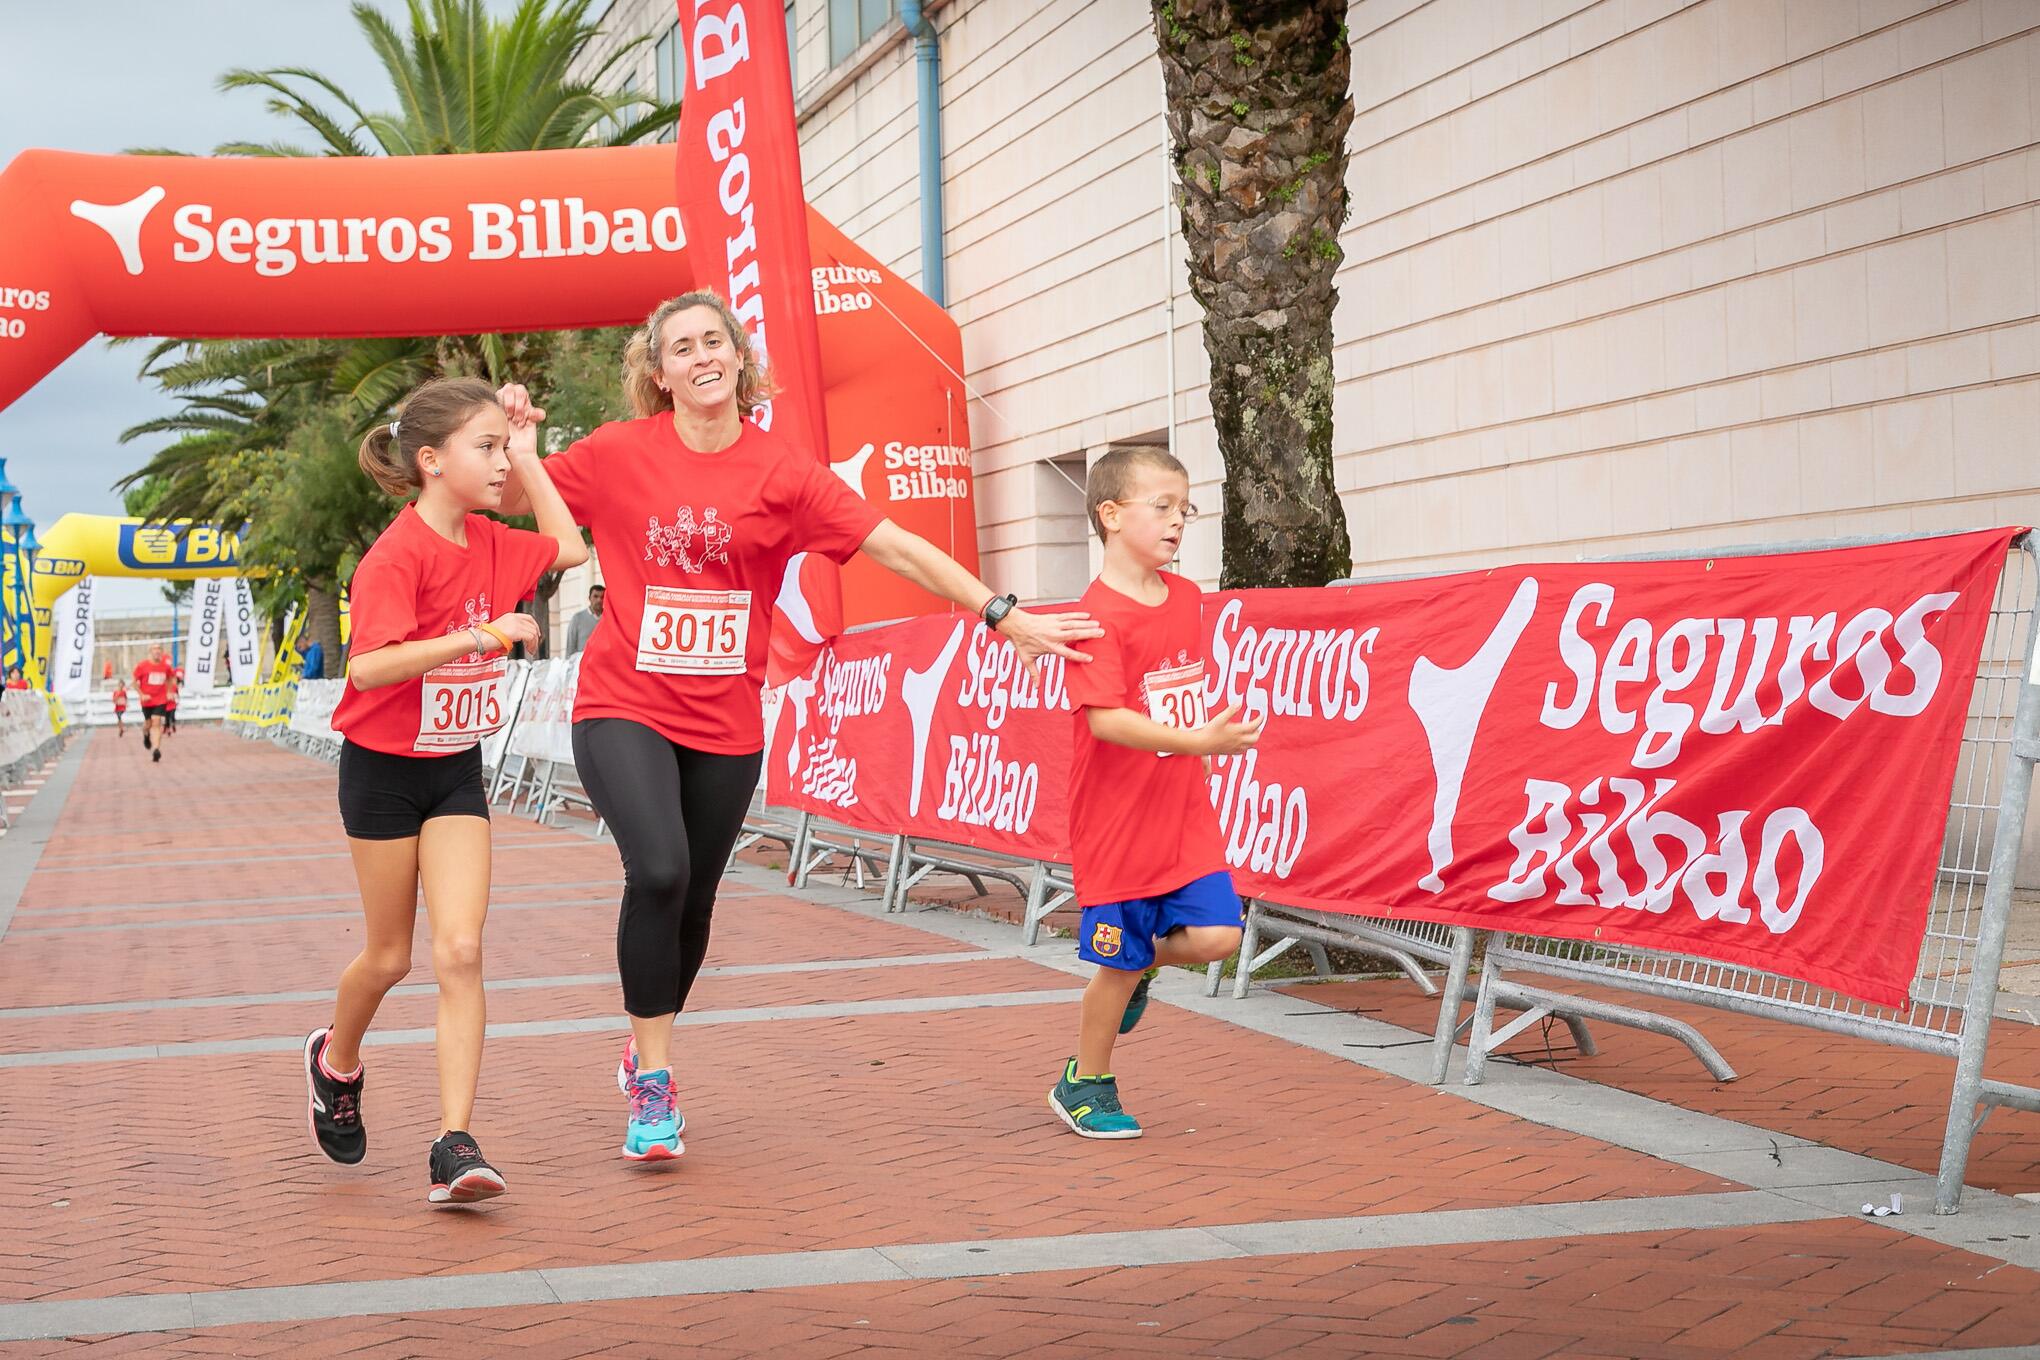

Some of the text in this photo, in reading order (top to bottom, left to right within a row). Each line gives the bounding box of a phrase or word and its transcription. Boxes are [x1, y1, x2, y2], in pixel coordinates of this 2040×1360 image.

[173, 197, 688, 277] Seguros Bilbao
[884, 441, 972, 472] Seguros
[887, 471, 968, 501] Bilbao
[54, 560, 83, 575] BM
[198, 577, 222, 674] EL CORRE
[240, 640, 253, 665] EL
[651, 611, 737, 654] 3015
[70, 656, 84, 679] EL
[433, 683, 500, 731] 3015
[818, 647, 892, 735] Seguros
[957, 621, 1072, 730] Seguro
[1204, 598, 1381, 736] Seguros
[1540, 582, 1961, 769] Seguros
[937, 732, 1039, 835] Bilbao
[1487, 776, 1826, 935] Bilbao
